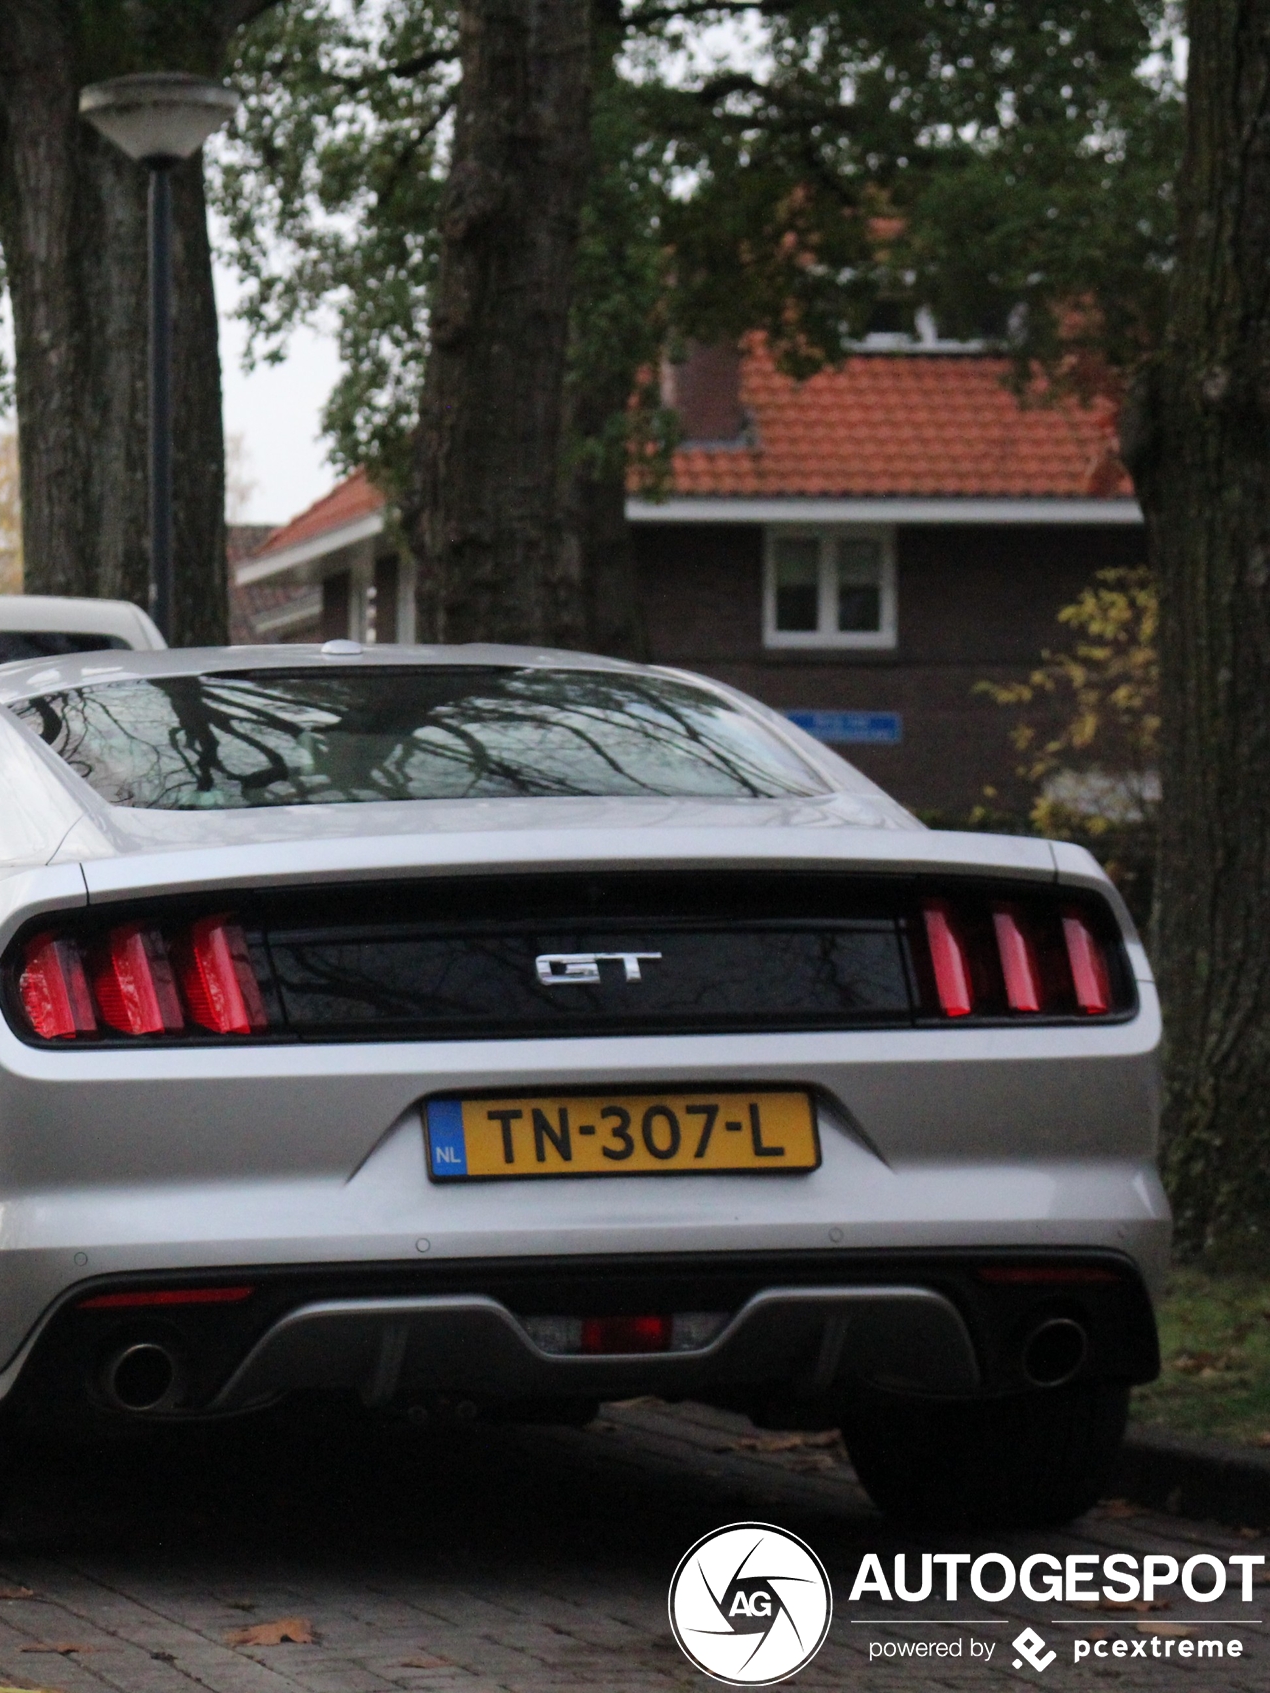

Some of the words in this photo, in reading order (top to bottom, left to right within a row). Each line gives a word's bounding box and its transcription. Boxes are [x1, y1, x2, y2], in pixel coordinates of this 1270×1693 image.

[534, 951, 663, 986] GT
[486, 1102, 785, 1164] TN-307-L
[435, 1146, 461, 1164] NL
